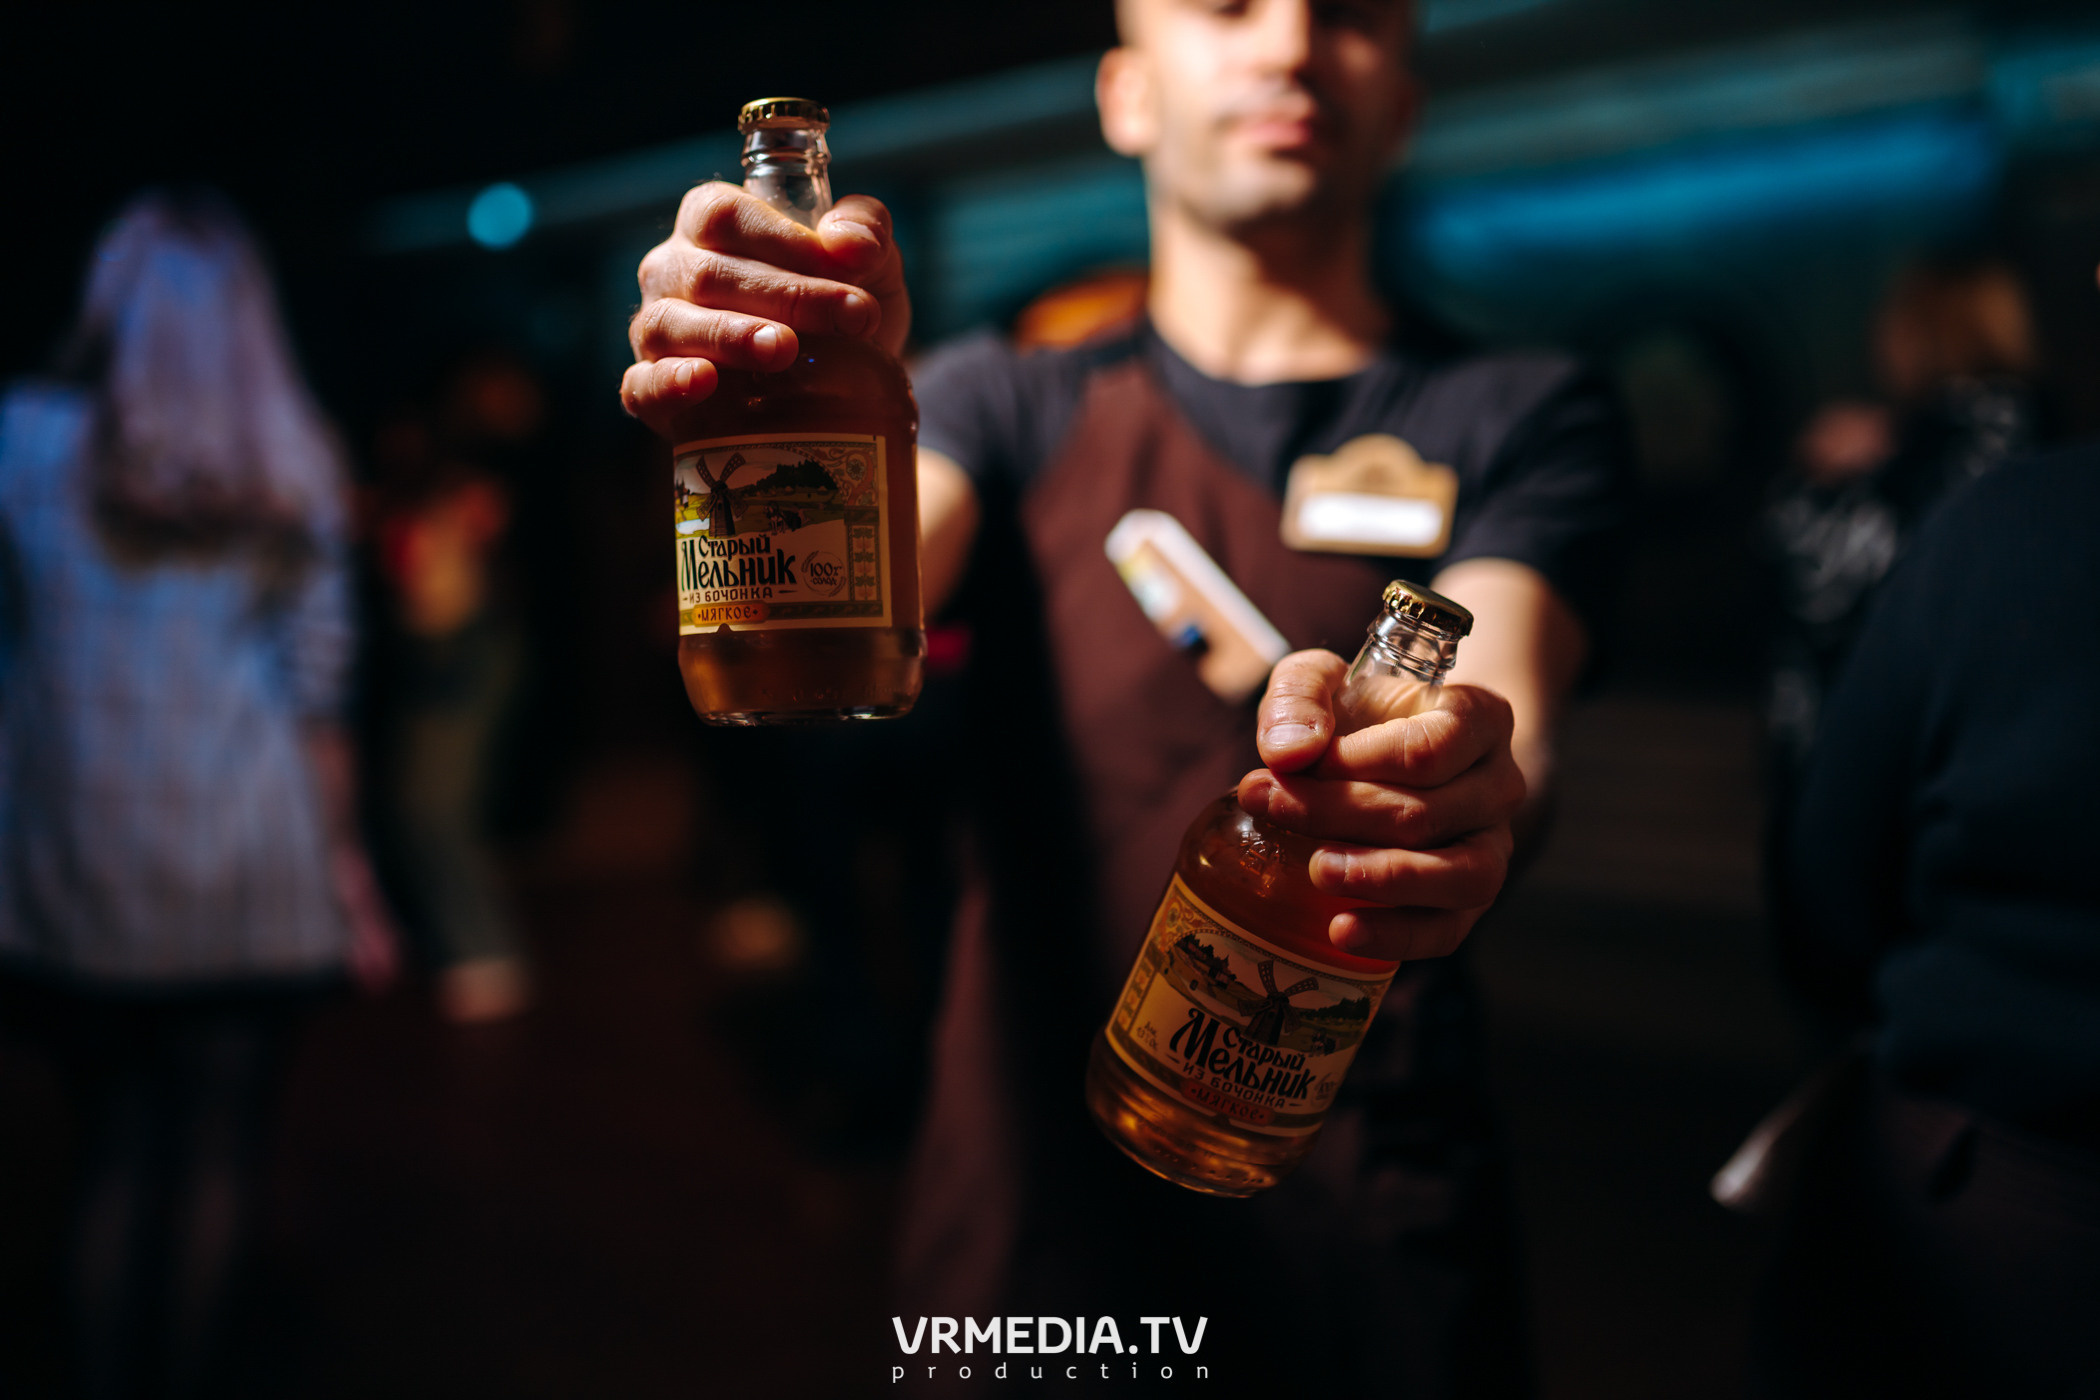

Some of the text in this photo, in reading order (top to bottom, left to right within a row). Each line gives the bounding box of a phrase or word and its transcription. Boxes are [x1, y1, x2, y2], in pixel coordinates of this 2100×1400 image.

[681, 540, 797, 591] Мельник
[699, 535, 770, 560] Старый
[1169, 1008, 1315, 1099] Мельник
[1222, 1026, 1306, 1071] Старый
